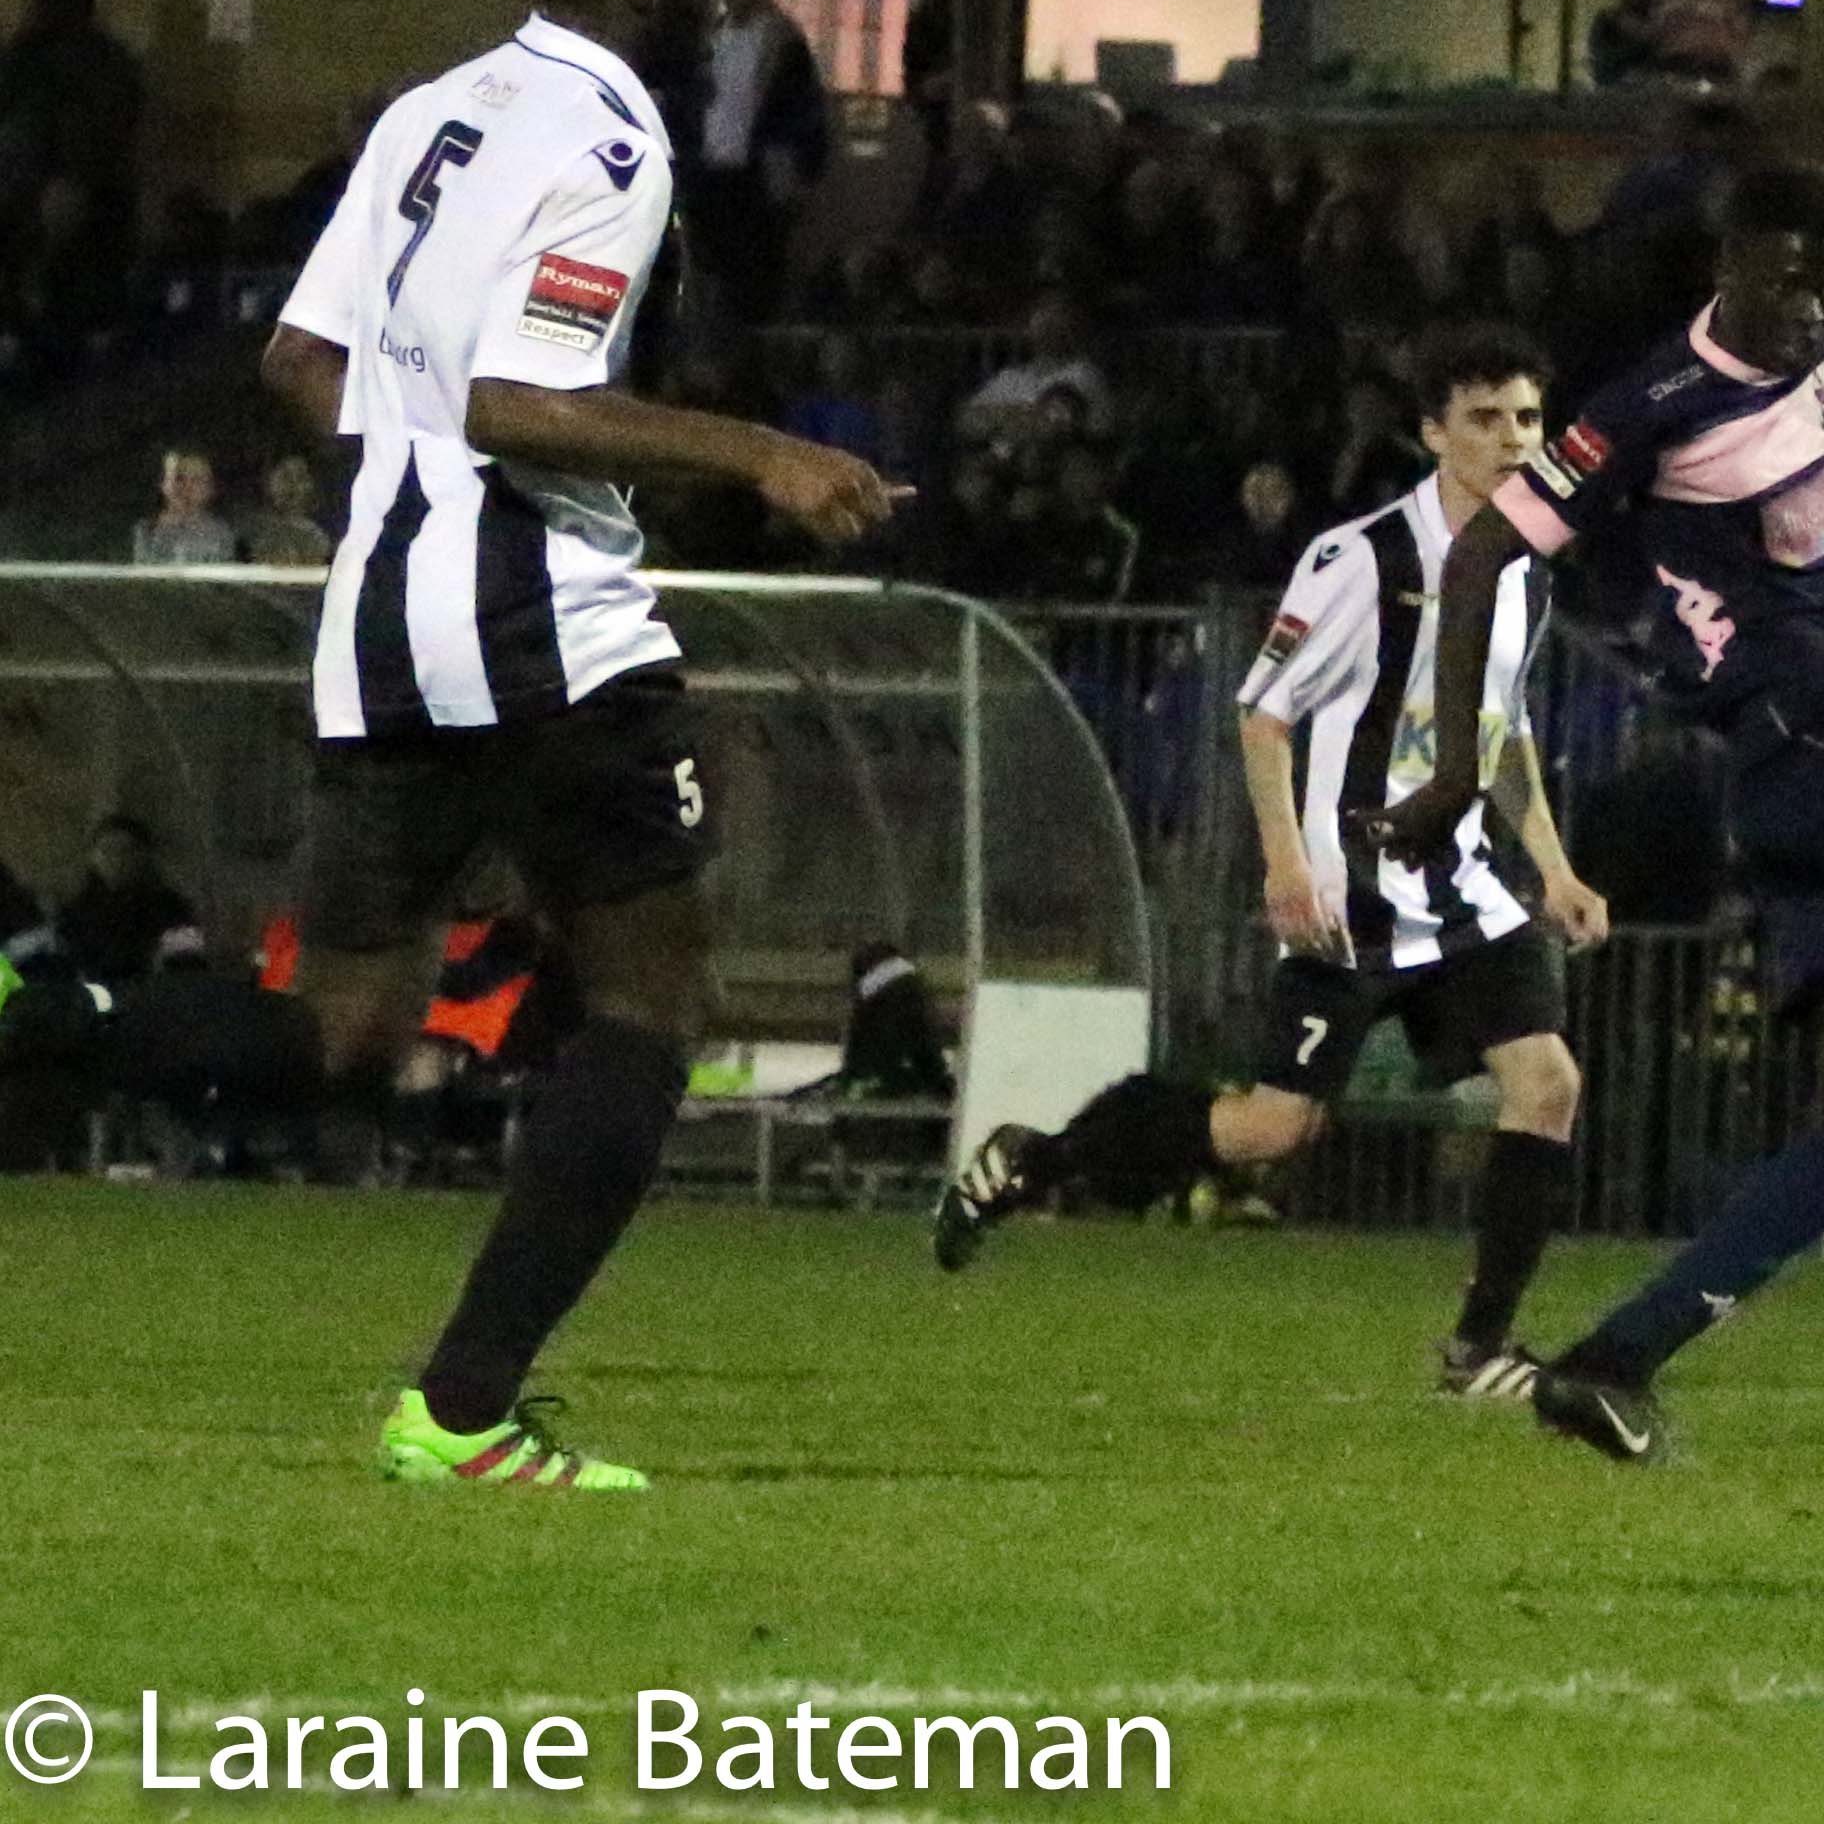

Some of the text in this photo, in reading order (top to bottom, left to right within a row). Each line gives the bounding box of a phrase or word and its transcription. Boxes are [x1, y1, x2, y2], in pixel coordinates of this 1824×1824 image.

[538, 265, 621, 299] Ryman
[523, 319, 586, 346] Respect
[673, 758, 704, 828] 5
[1297, 1016, 1328, 1065] 7
